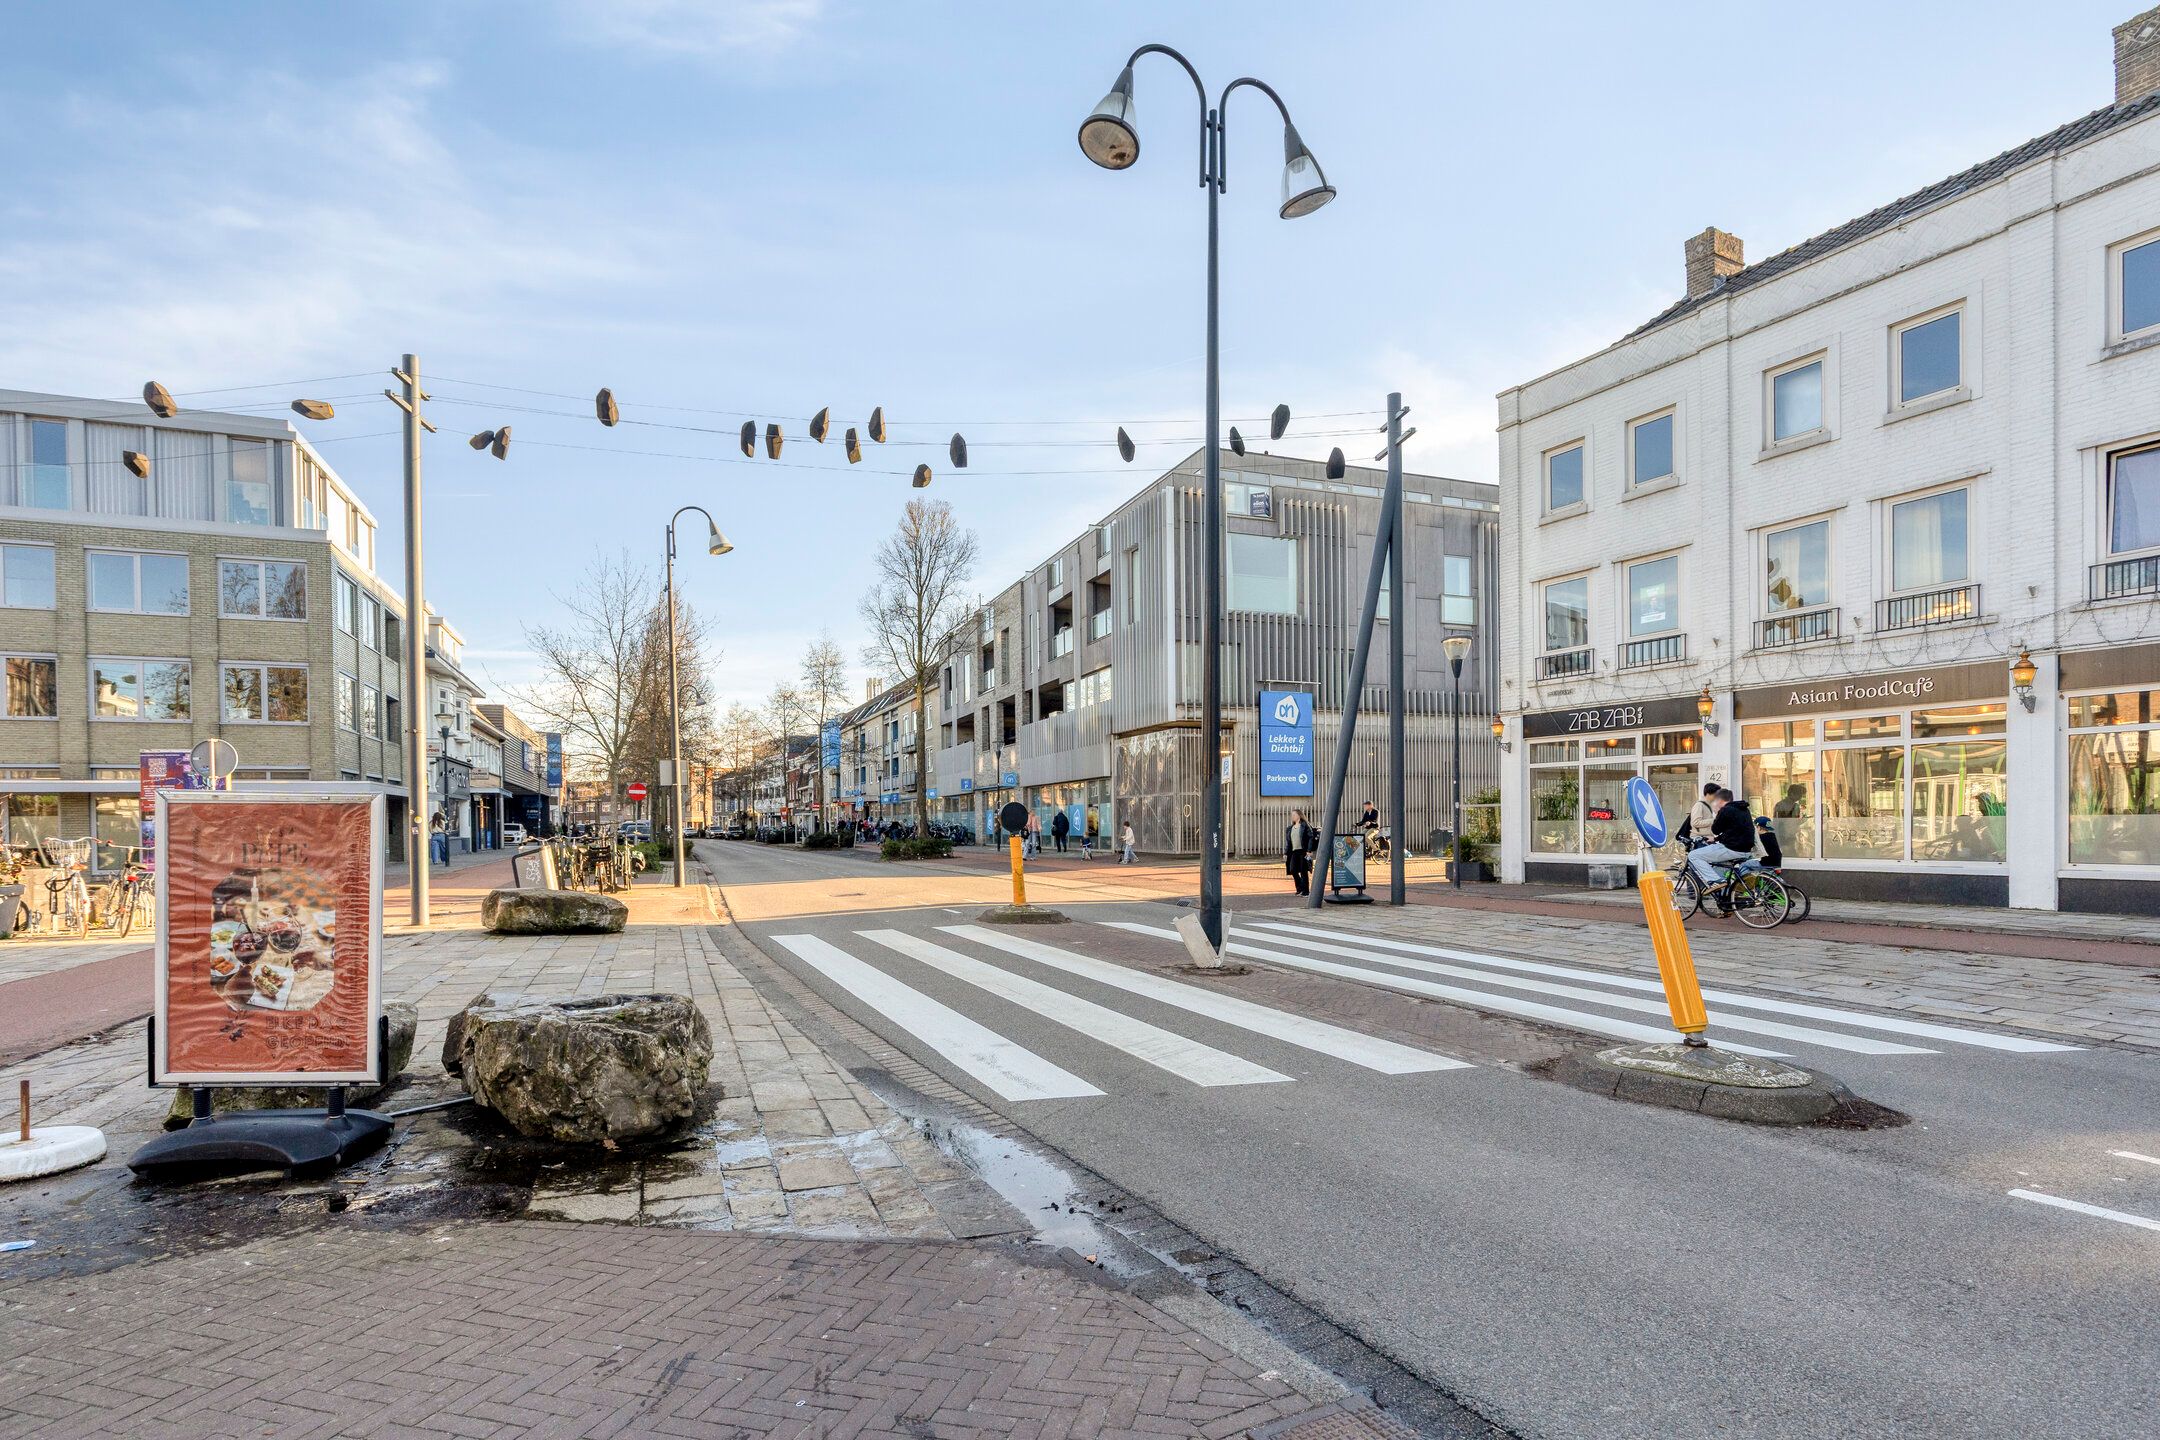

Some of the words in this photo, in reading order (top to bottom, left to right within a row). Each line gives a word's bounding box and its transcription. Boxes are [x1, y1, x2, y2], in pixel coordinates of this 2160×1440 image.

[1787, 689, 1839, 706] Asian
[1844, 676, 1935, 701] FoodCafé
[1568, 710, 1601, 732] ZAB
[1603, 706, 1637, 729] ZAB
[1268, 734, 1297, 744] Lekker
[1298, 735, 1306, 744] &
[1270, 744, 1304, 755] Dichtbij
[1266, 774, 1297, 782] Parkeren
[1709, 772, 1722, 782] 42
[1590, 810, 1612, 819] OPEN
